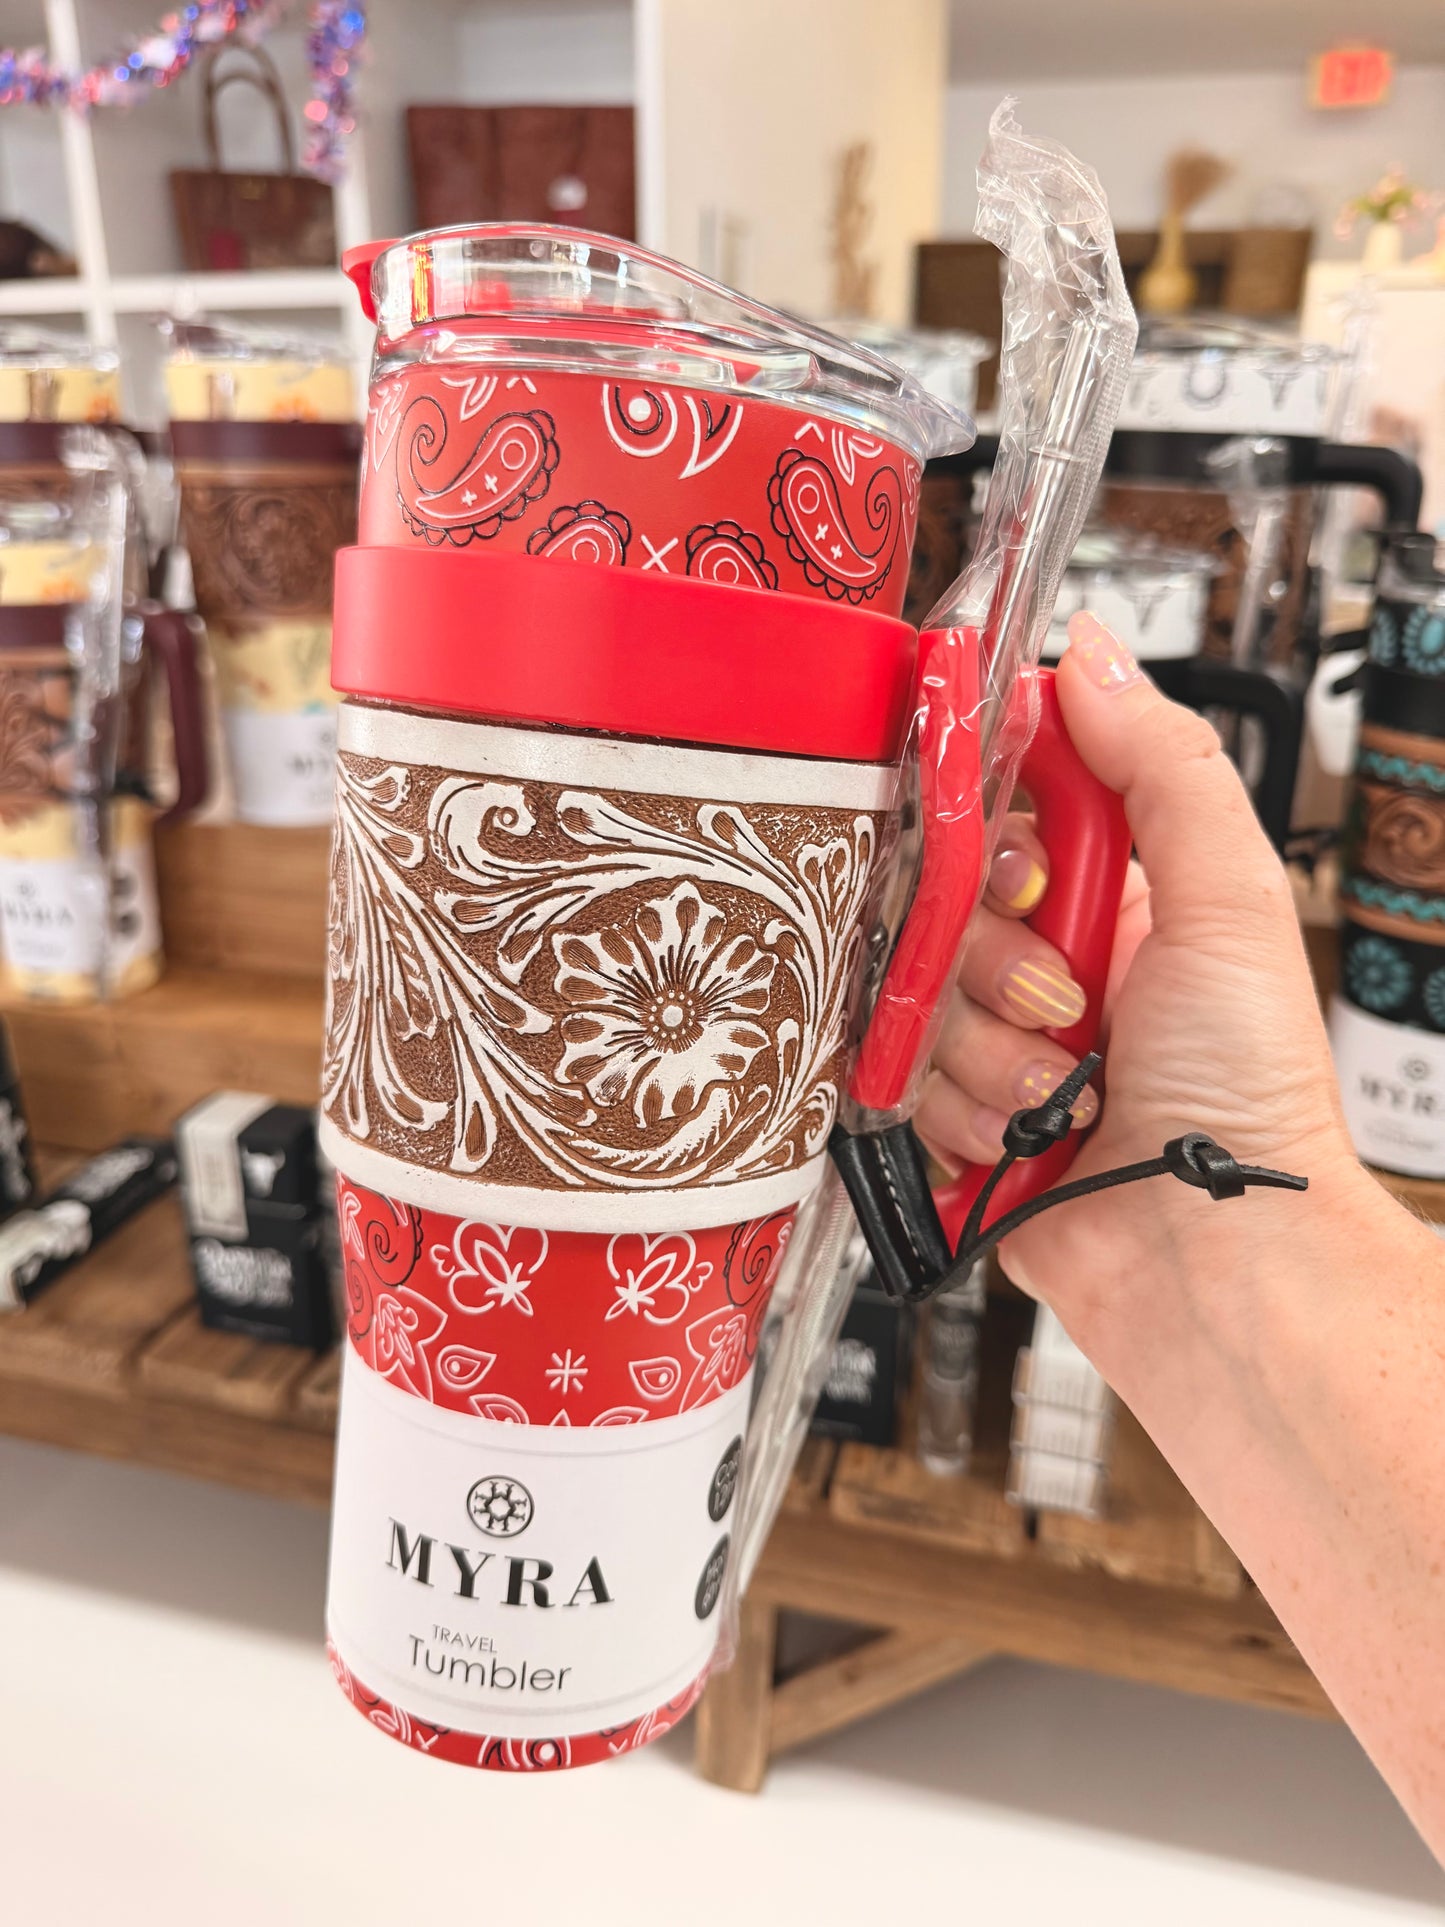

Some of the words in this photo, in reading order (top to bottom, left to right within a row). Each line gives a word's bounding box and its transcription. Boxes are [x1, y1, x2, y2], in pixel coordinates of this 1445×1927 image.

[1360, 1073, 1445, 1117] MYR
[386, 1516, 615, 1609] MYRA
[409, 1633, 572, 1692] Tumbler
[432, 1623, 498, 1654] TRAVEL
